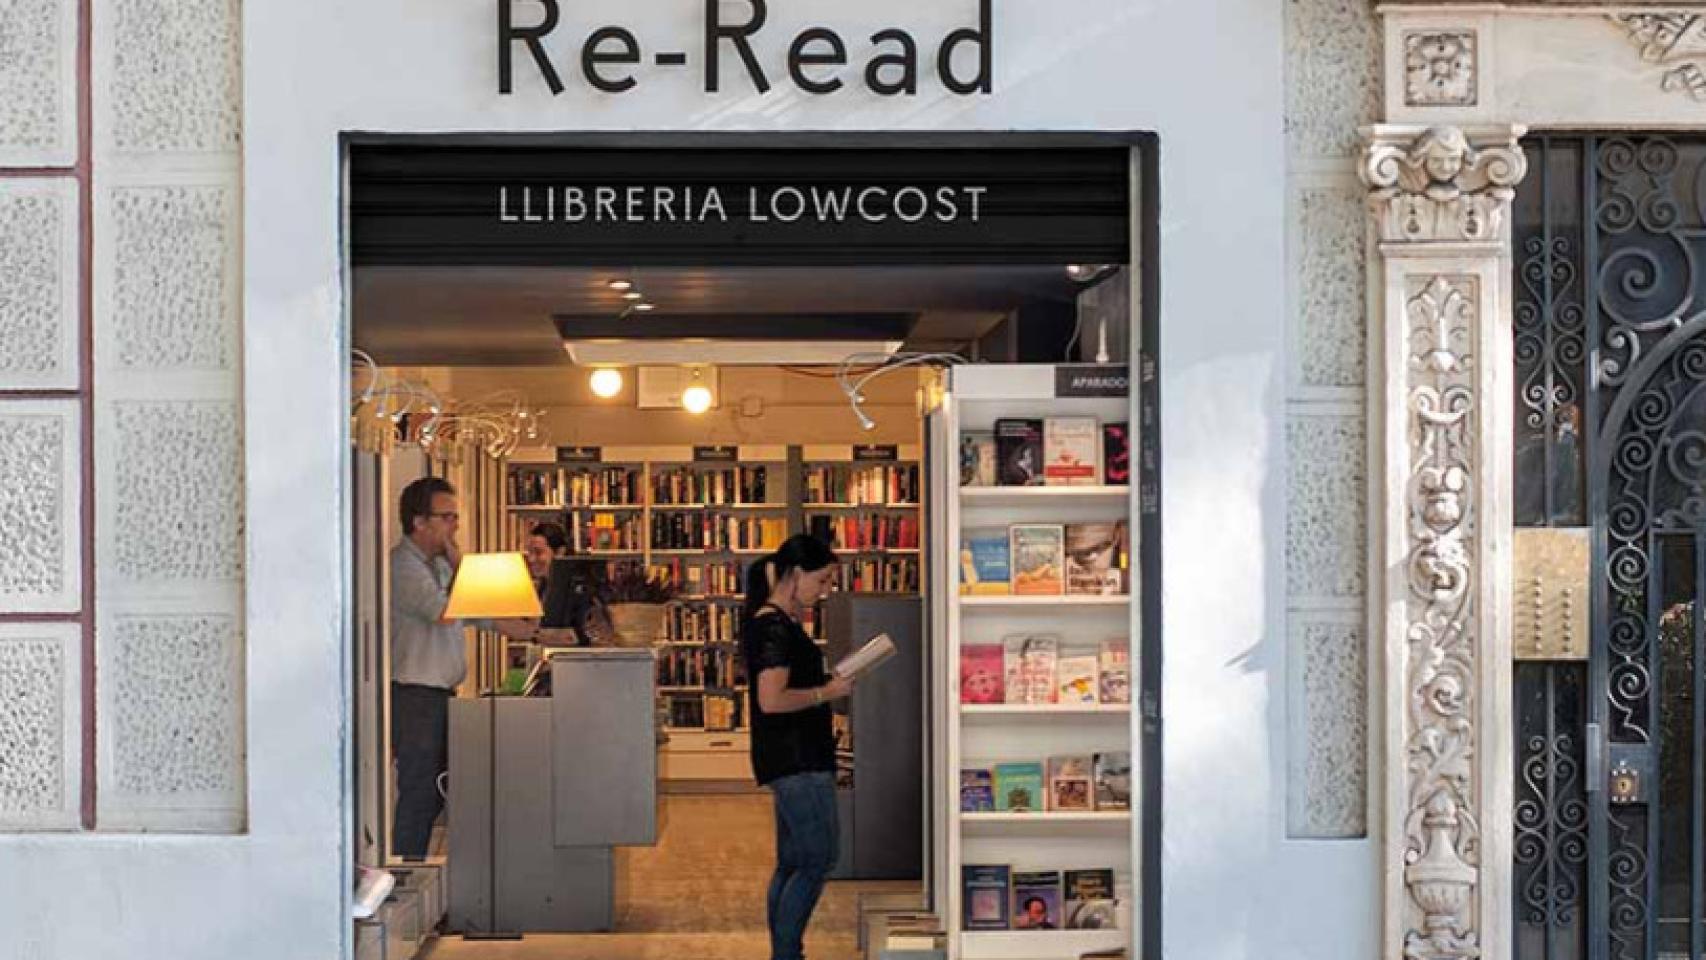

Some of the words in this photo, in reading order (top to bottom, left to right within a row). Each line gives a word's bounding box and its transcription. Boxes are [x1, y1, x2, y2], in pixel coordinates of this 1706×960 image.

[498, 0, 993, 96] Re-Read
[499, 186, 727, 222] LLIBRERIA
[749, 186, 988, 222] LOWCOST
